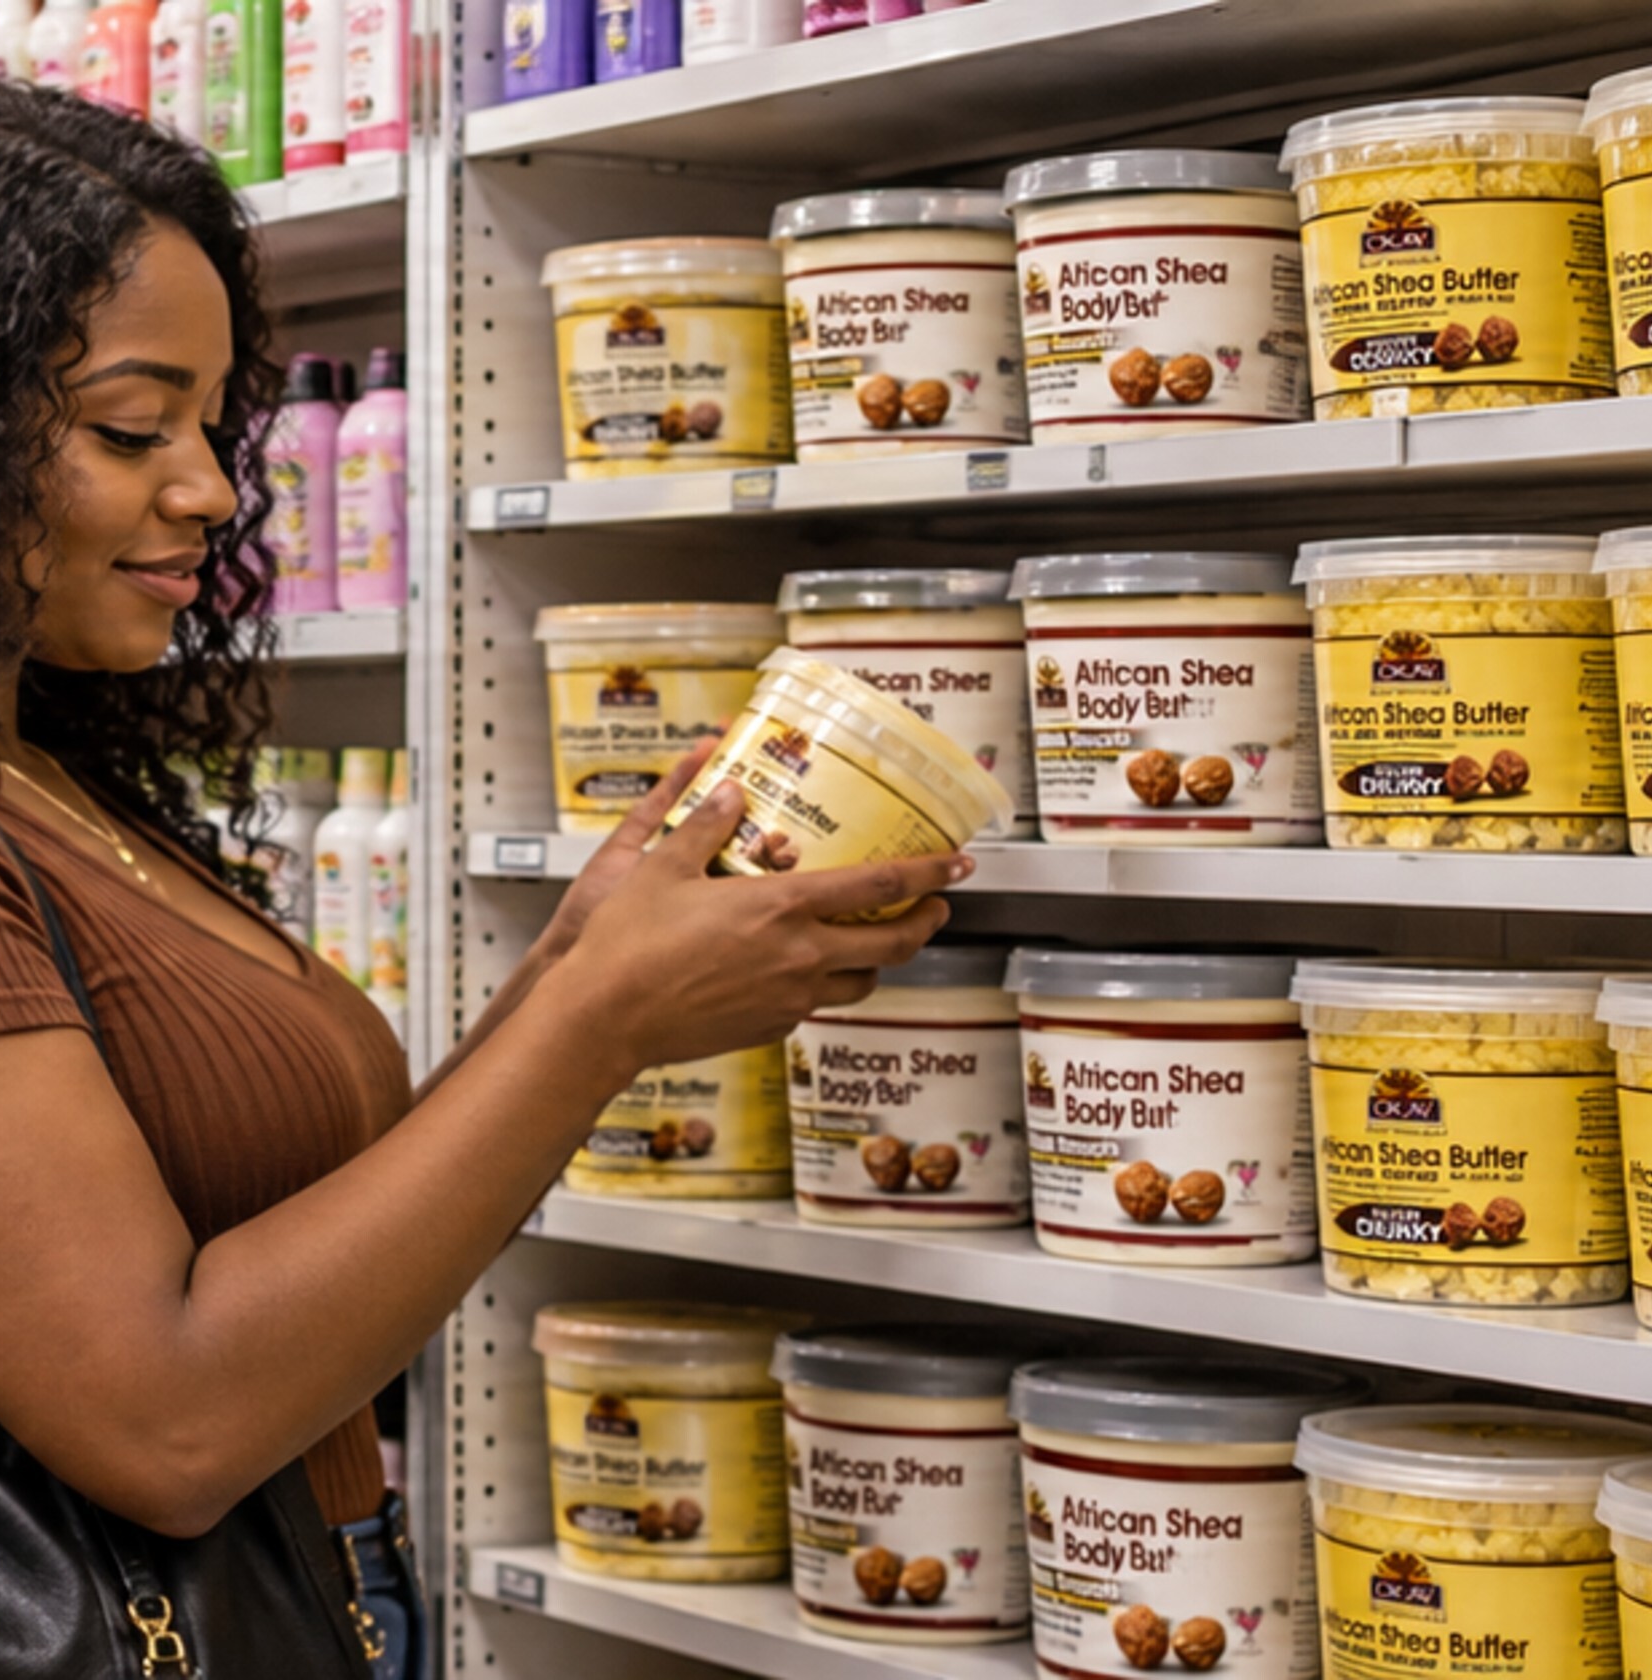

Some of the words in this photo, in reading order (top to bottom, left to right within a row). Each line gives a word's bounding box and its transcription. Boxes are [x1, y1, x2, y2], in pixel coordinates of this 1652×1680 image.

[1156, 257, 1228, 285] Shea
[1373, 272, 1435, 297] Shea
[1443, 268, 1520, 292] Butter
[904, 288, 970, 313] Shea
[1181, 659, 1254, 687] Shea
[1077, 692, 1140, 724] Body
[1383, 700, 1444, 725] Shea
[1453, 701, 1530, 726] Butter
[908, 1048, 977, 1076] Shea
[1168, 1064, 1244, 1095] Shea
[1065, 1096, 1126, 1131] Body
[1378, 1143, 1442, 1167] Shea
[1449, 1144, 1529, 1170] Butter
[894, 1457, 964, 1487] Shea
[1165, 1508, 1243, 1540] Shea
[1063, 1531, 1126, 1574] Body
[1379, 1622, 1441, 1655] Shea
[1449, 1633, 1530, 1661] Butter
